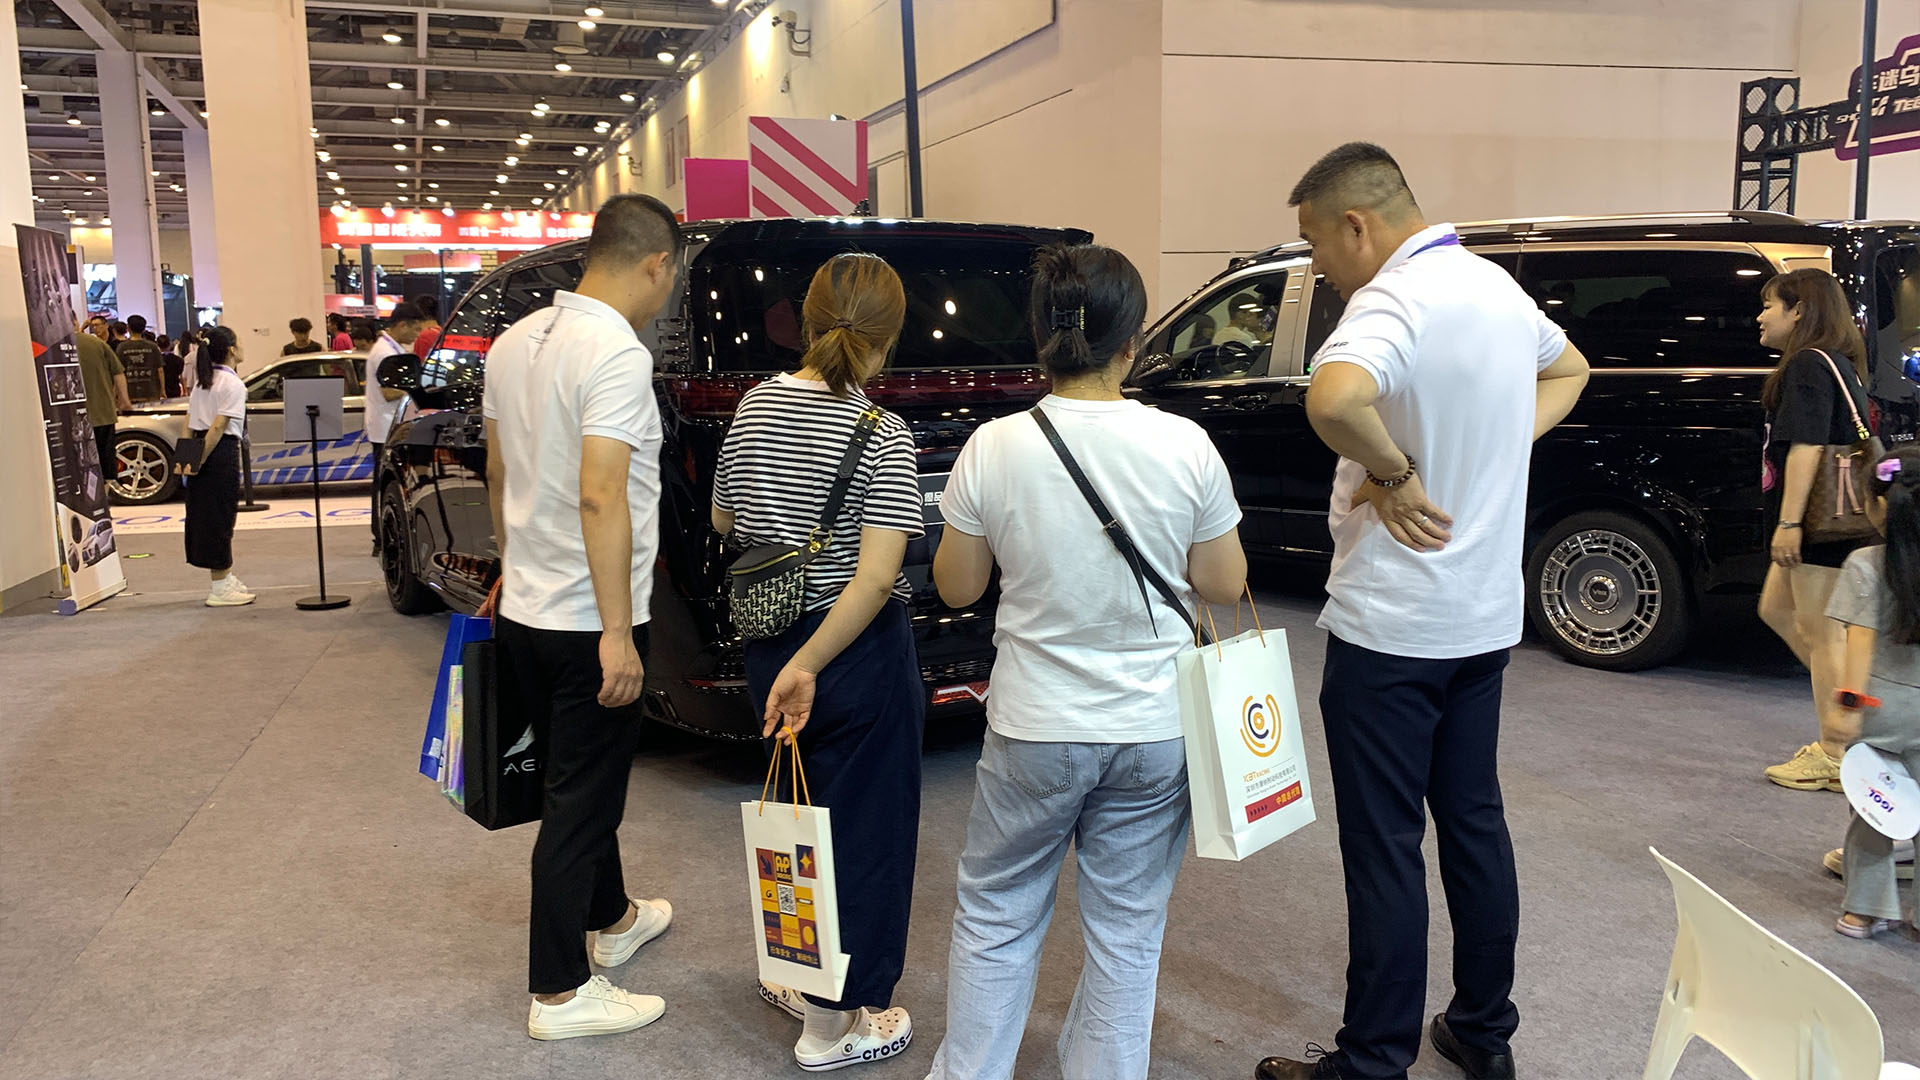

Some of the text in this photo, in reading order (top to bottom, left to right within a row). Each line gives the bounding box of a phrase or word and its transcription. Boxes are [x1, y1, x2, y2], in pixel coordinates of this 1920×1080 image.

[503, 758, 542, 776] AE
[1868, 789, 1895, 812] IGOL
[862, 1035, 907, 1061] crocs
